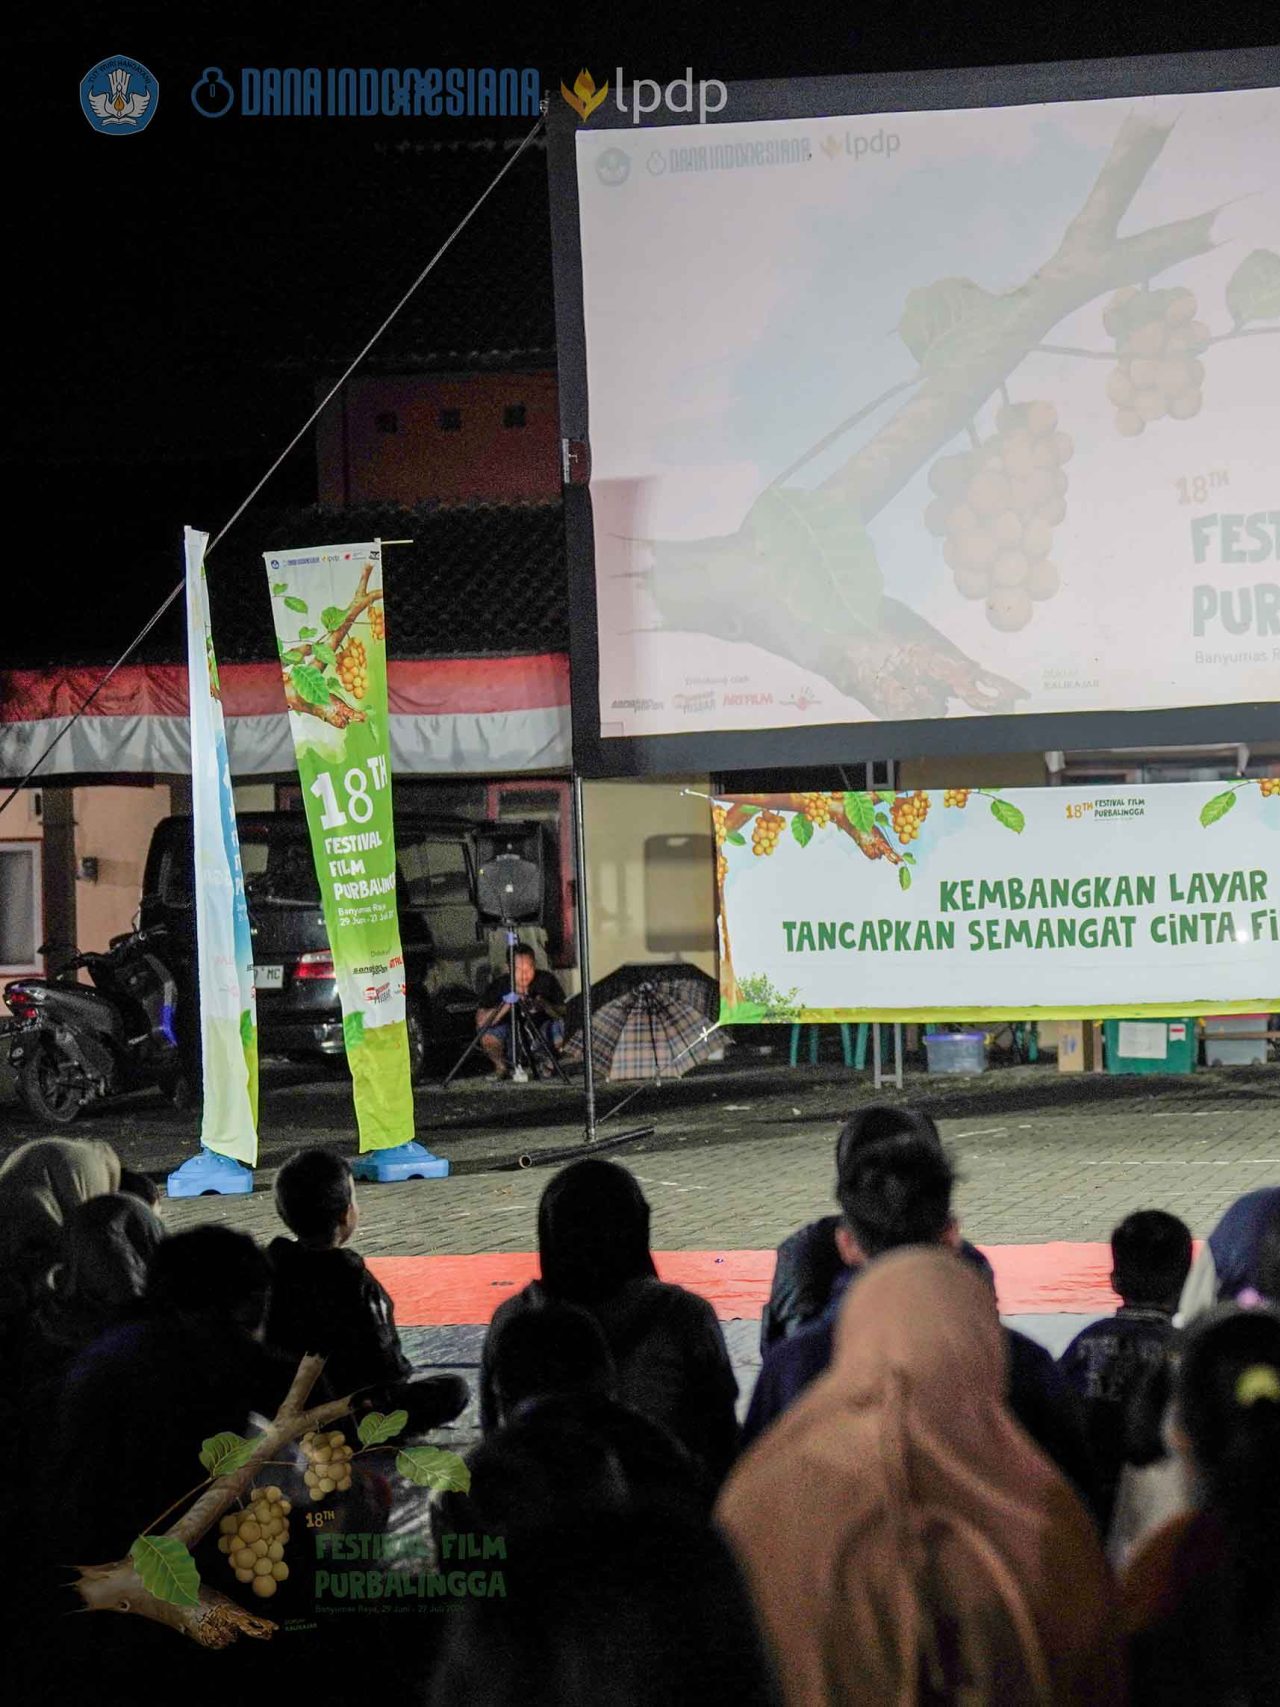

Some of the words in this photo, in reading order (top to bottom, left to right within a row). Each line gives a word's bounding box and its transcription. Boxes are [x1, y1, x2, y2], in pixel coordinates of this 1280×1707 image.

[847, 129, 901, 161] lpdp
[1094, 808, 1145, 817] PURBALINGGA
[325, 831, 383, 855] FESTIVAL
[329, 859, 366, 878] FILM
[939, 876, 1156, 912] KEMBANGKAN
[1169, 870, 1268, 904] LAYAR
[782, 919, 955, 952] TANCAPKAN
[968, 916, 1136, 951] SEMANGAT
